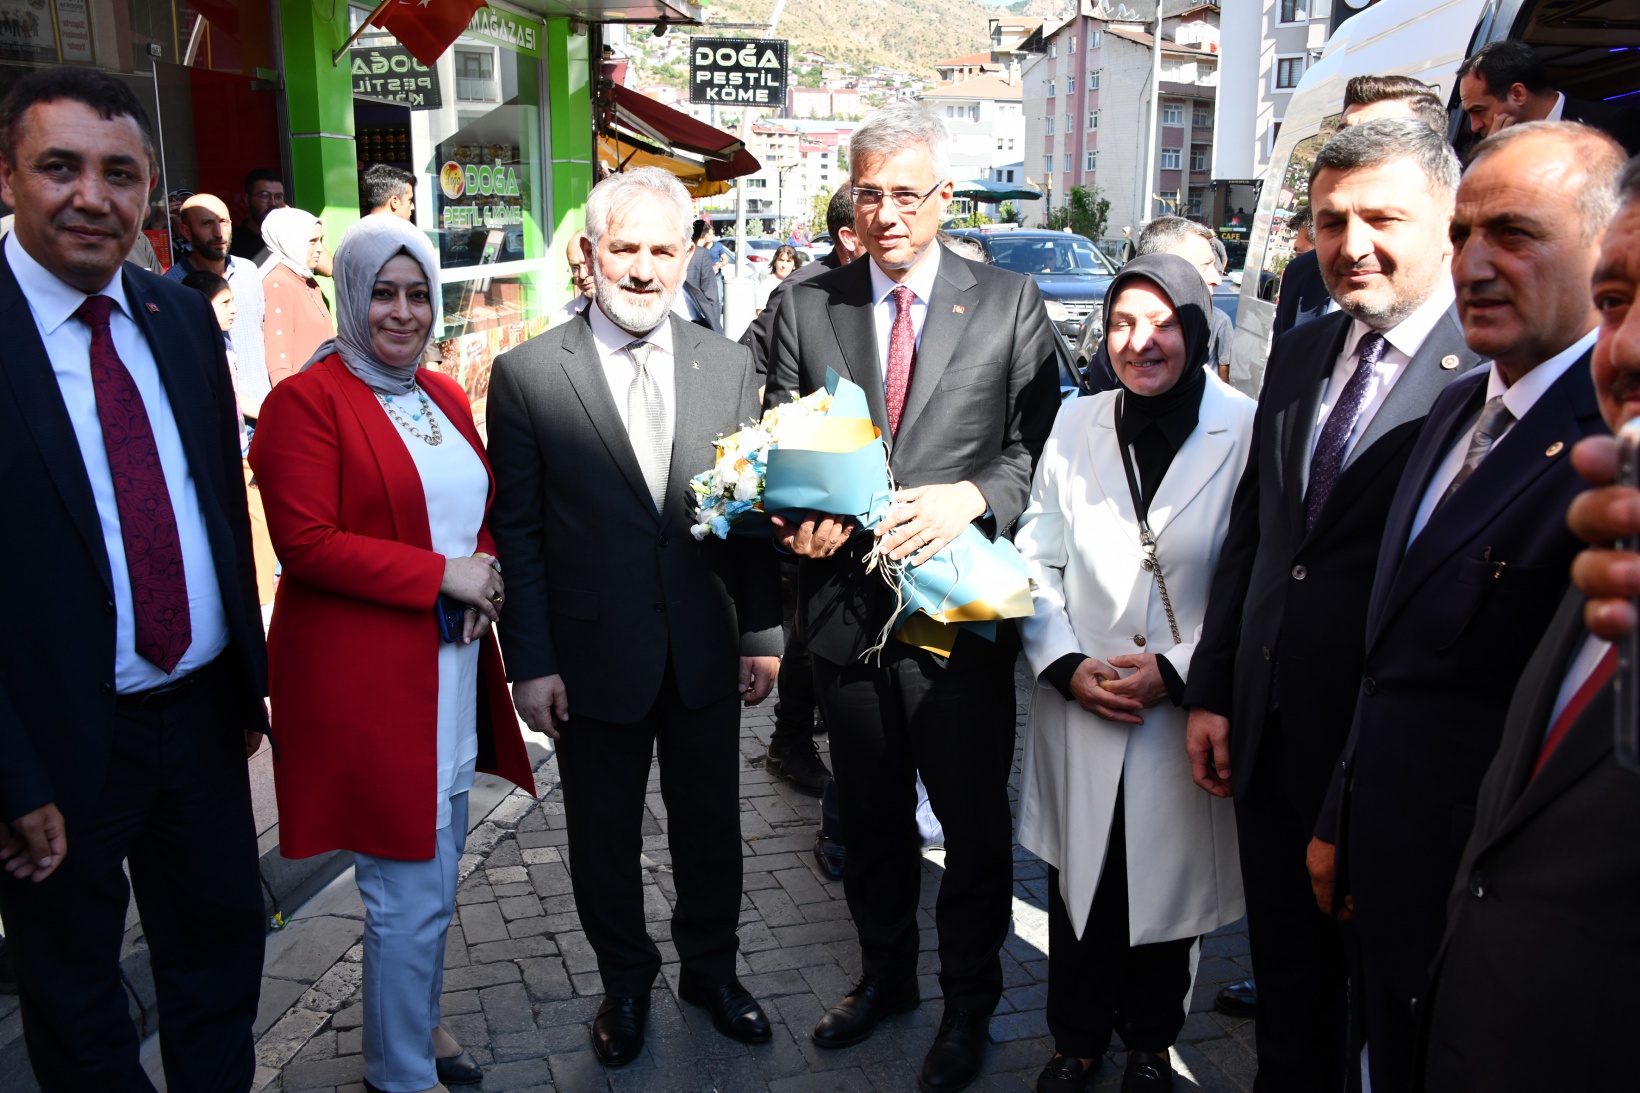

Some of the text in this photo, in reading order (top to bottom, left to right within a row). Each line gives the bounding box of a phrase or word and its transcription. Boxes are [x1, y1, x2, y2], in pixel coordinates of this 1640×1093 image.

[468, 9, 536, 51] MAĞAZASI
[695, 44, 781, 69] DOĞA
[696, 69, 780, 87] PESTİL
[706, 85, 769, 102] KÖME
[465, 159, 520, 196] DOĞA
[443, 201, 483, 229] PESTİL
[1221, 232, 1240, 240] CAFE
